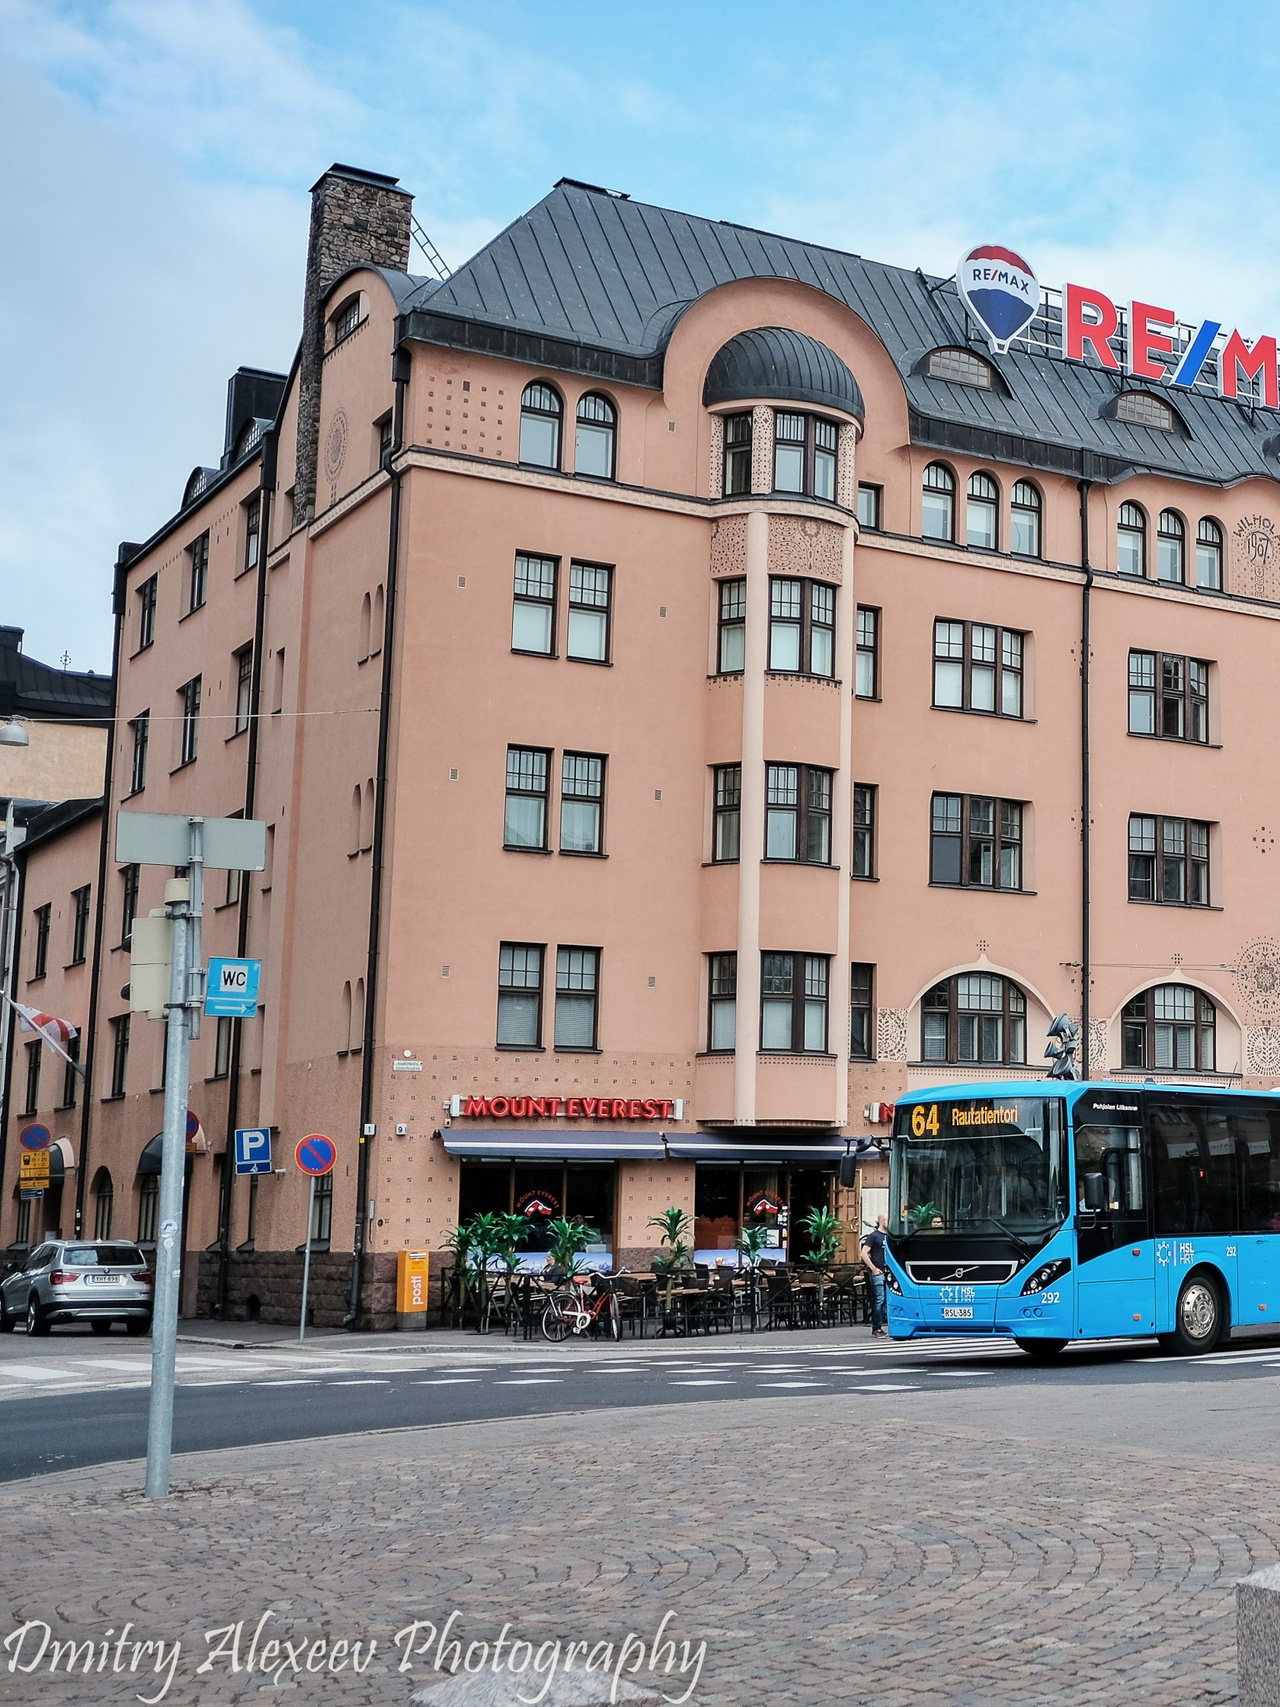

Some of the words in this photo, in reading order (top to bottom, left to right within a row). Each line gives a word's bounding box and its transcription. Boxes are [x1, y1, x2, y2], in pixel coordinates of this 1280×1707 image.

[973, 269, 1029, 294] RE/MAX
[223, 970, 246, 986] WC
[465, 1095, 564, 1118] MOUNT
[565, 1097, 672, 1119] EVEREST
[912, 1105, 940, 1136] 64
[952, 1105, 1018, 1126] Rautatientori
[243, 1131, 265, 1160] P
[516, 1190, 536, 1208] MOUNT
[537, 1190, 560, 1208] EVEREST
[1180, 1243, 1195, 1253] HSL
[1226, 1246, 1236, 1256] 292
[1180, 1254, 1194, 1264] HRT
[411, 1276, 424, 1305] posti
[961, 1286, 975, 1295] HSL
[1041, 1292, 1060, 1303] 292
